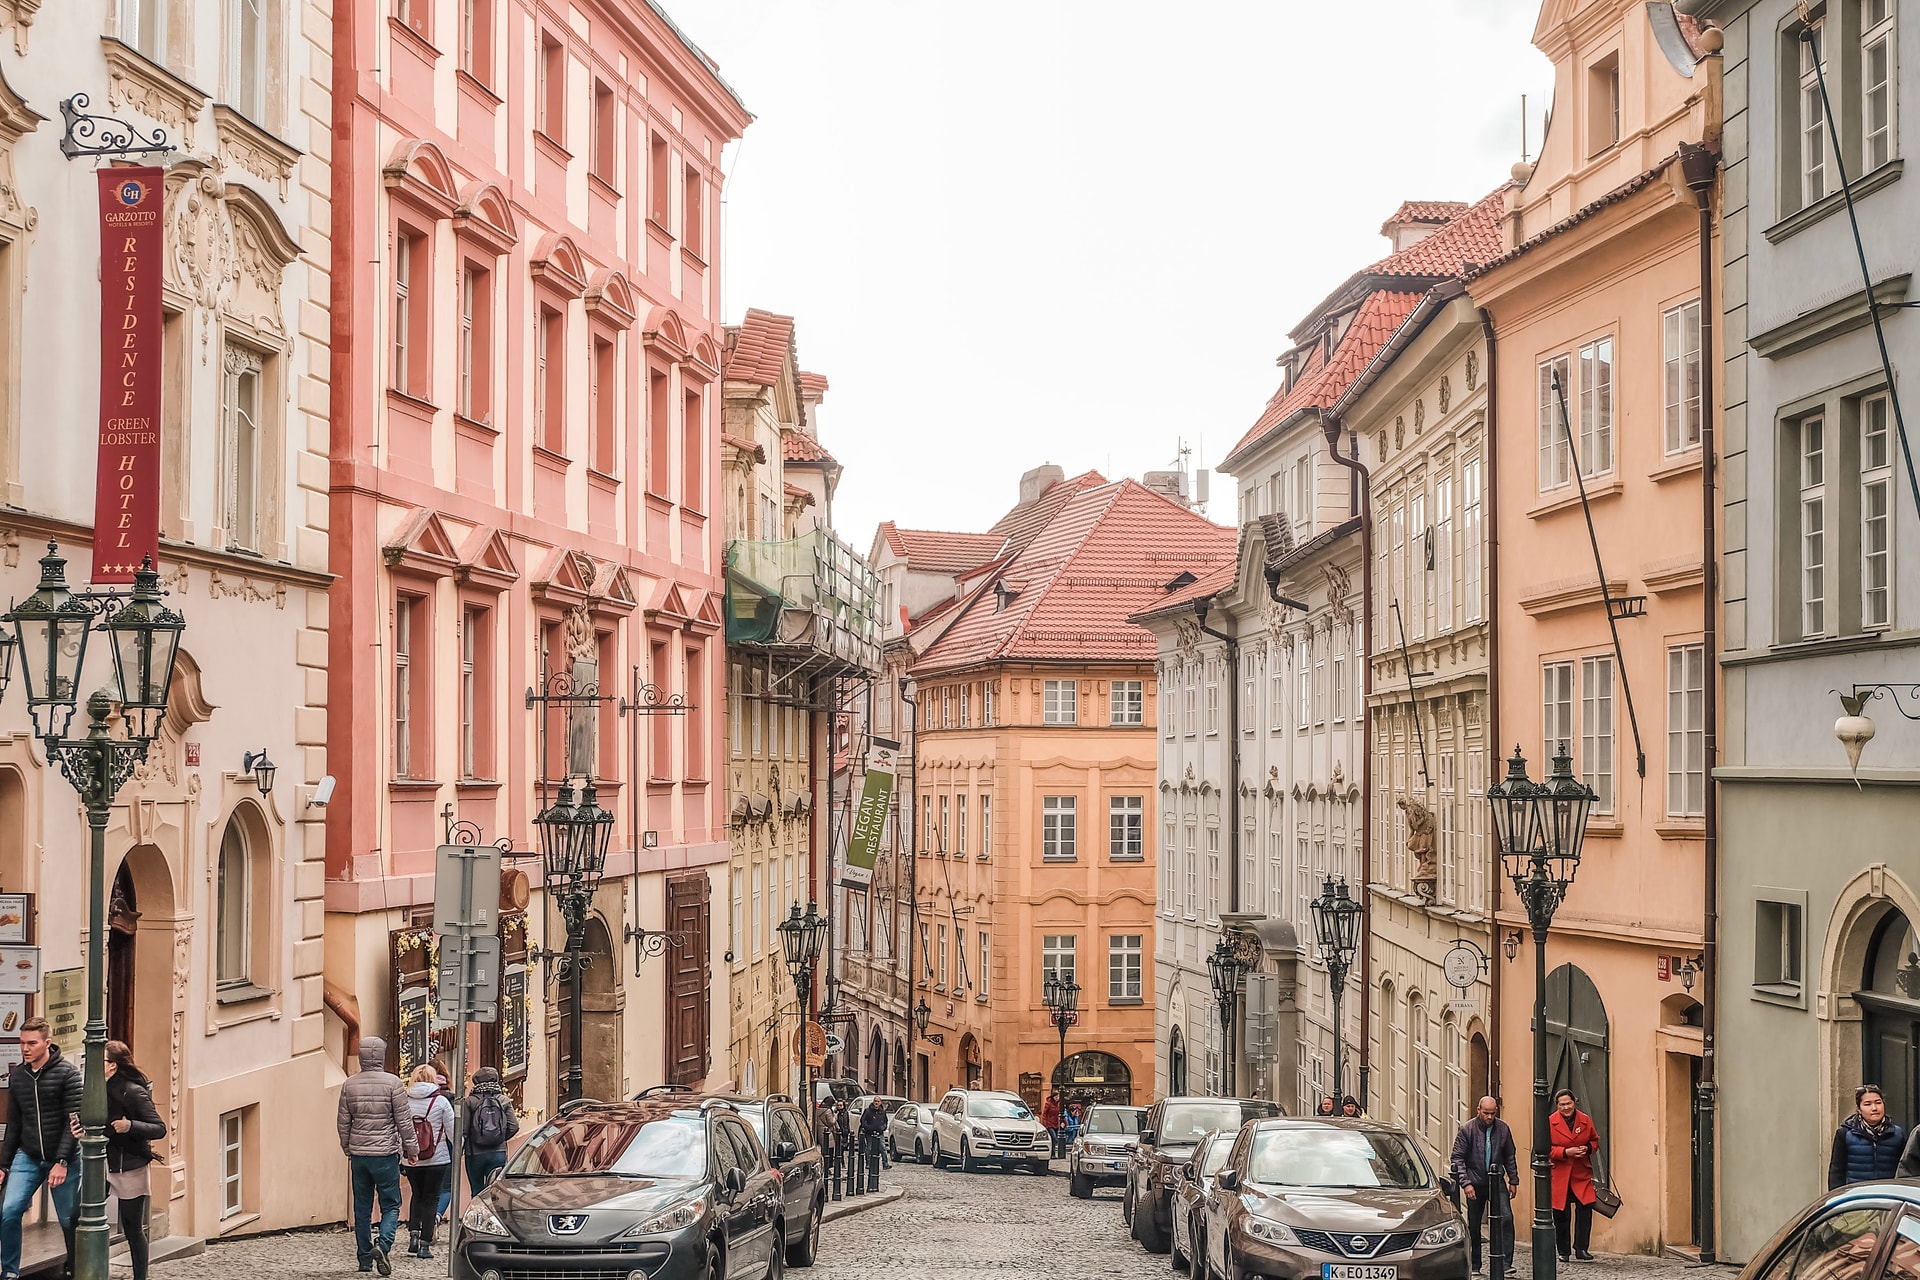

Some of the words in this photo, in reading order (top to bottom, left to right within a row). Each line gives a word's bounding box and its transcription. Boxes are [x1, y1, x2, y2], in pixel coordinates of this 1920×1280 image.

[105, 211, 157, 222] GARZOTTO
[121, 237, 138, 407] RESIDENCE
[107, 417, 151, 431] GREEN
[100, 432, 157, 446] LOBSTER
[116, 455, 137, 548] HOTEL
[854, 796, 875, 841] VEGAN
[865, 788, 889, 855] RESTAURANT
[53, 1024, 77, 1036] LOBSTER
[1365, 1267, 1395, 1280] 1349
